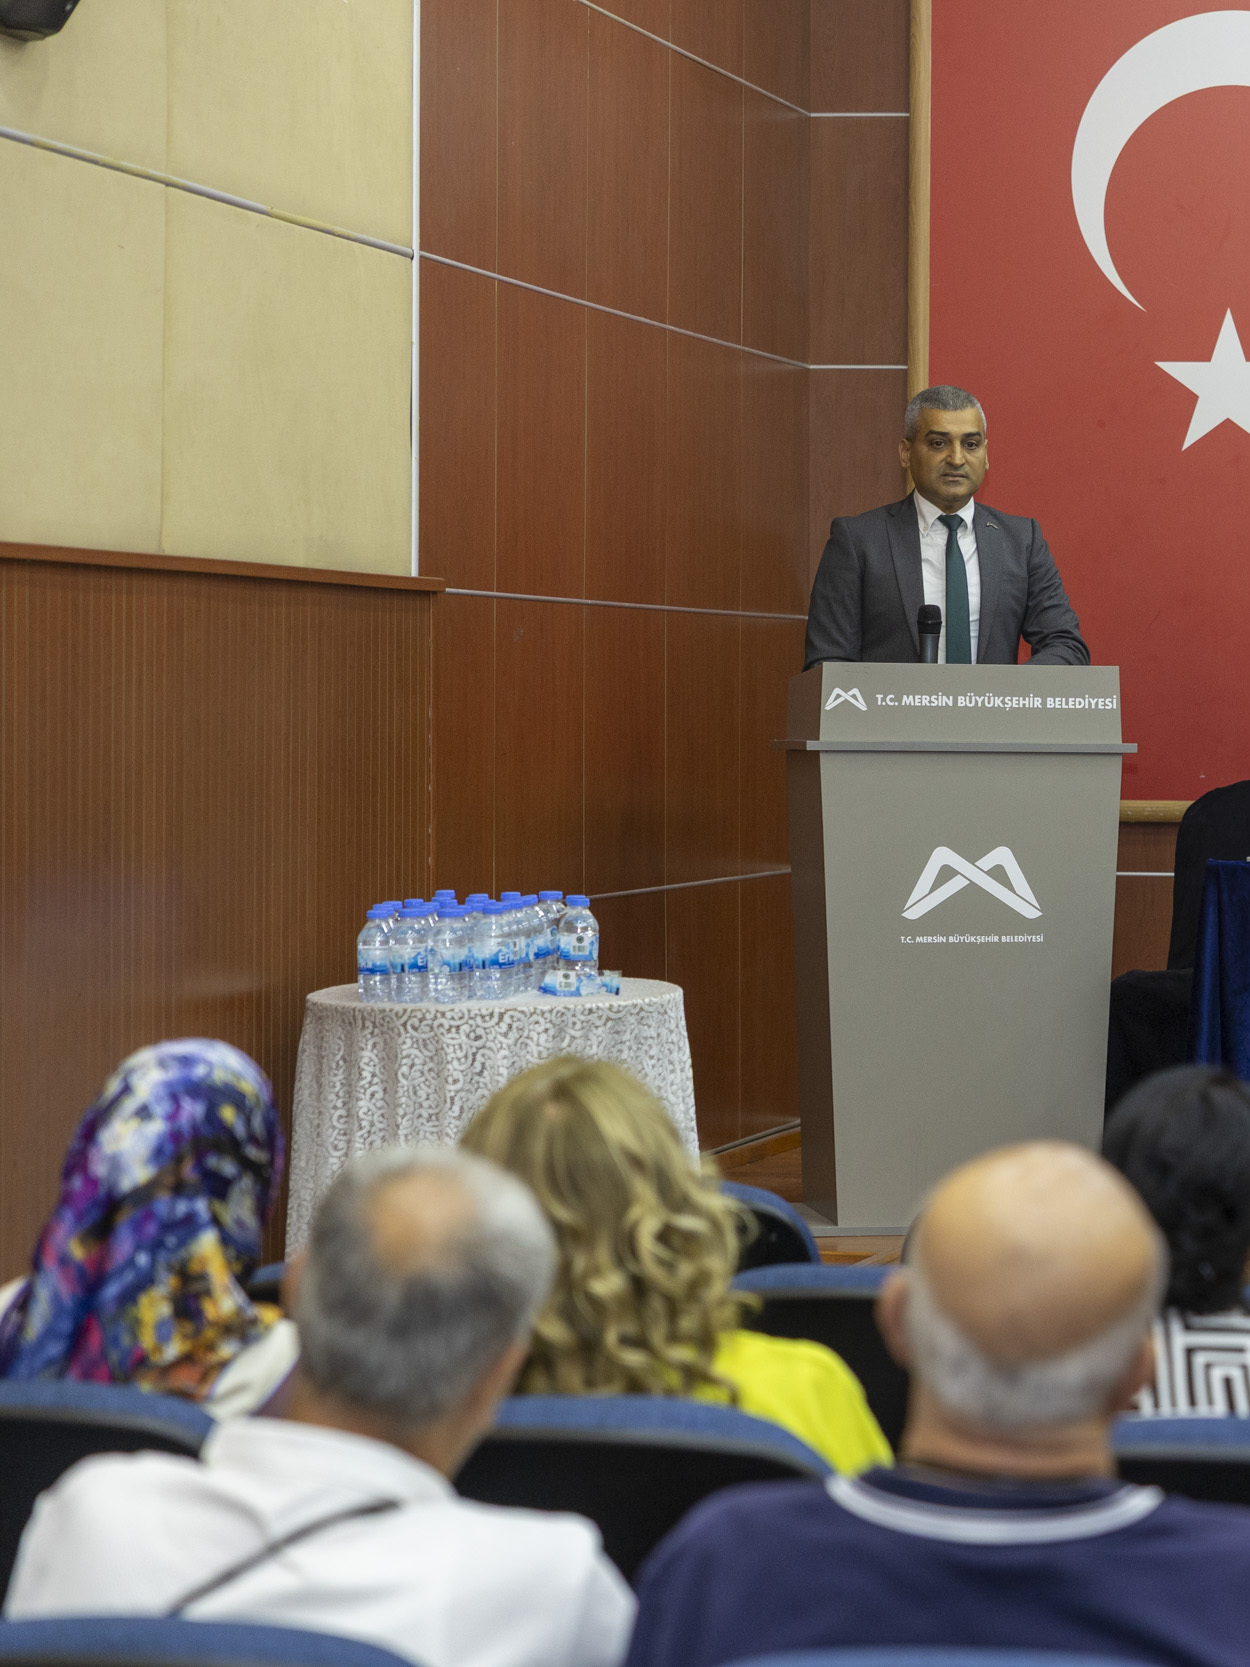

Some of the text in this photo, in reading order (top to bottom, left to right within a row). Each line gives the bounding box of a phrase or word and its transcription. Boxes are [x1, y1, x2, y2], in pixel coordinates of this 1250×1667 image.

[875, 692, 1117, 711] T.C. MERSİN BÜYÜKŞEHİR BELEDİYESİ
[900, 933, 1044, 945] T.C. MERSİN BÜYÜKŞEHİR BELEDİYESİ
